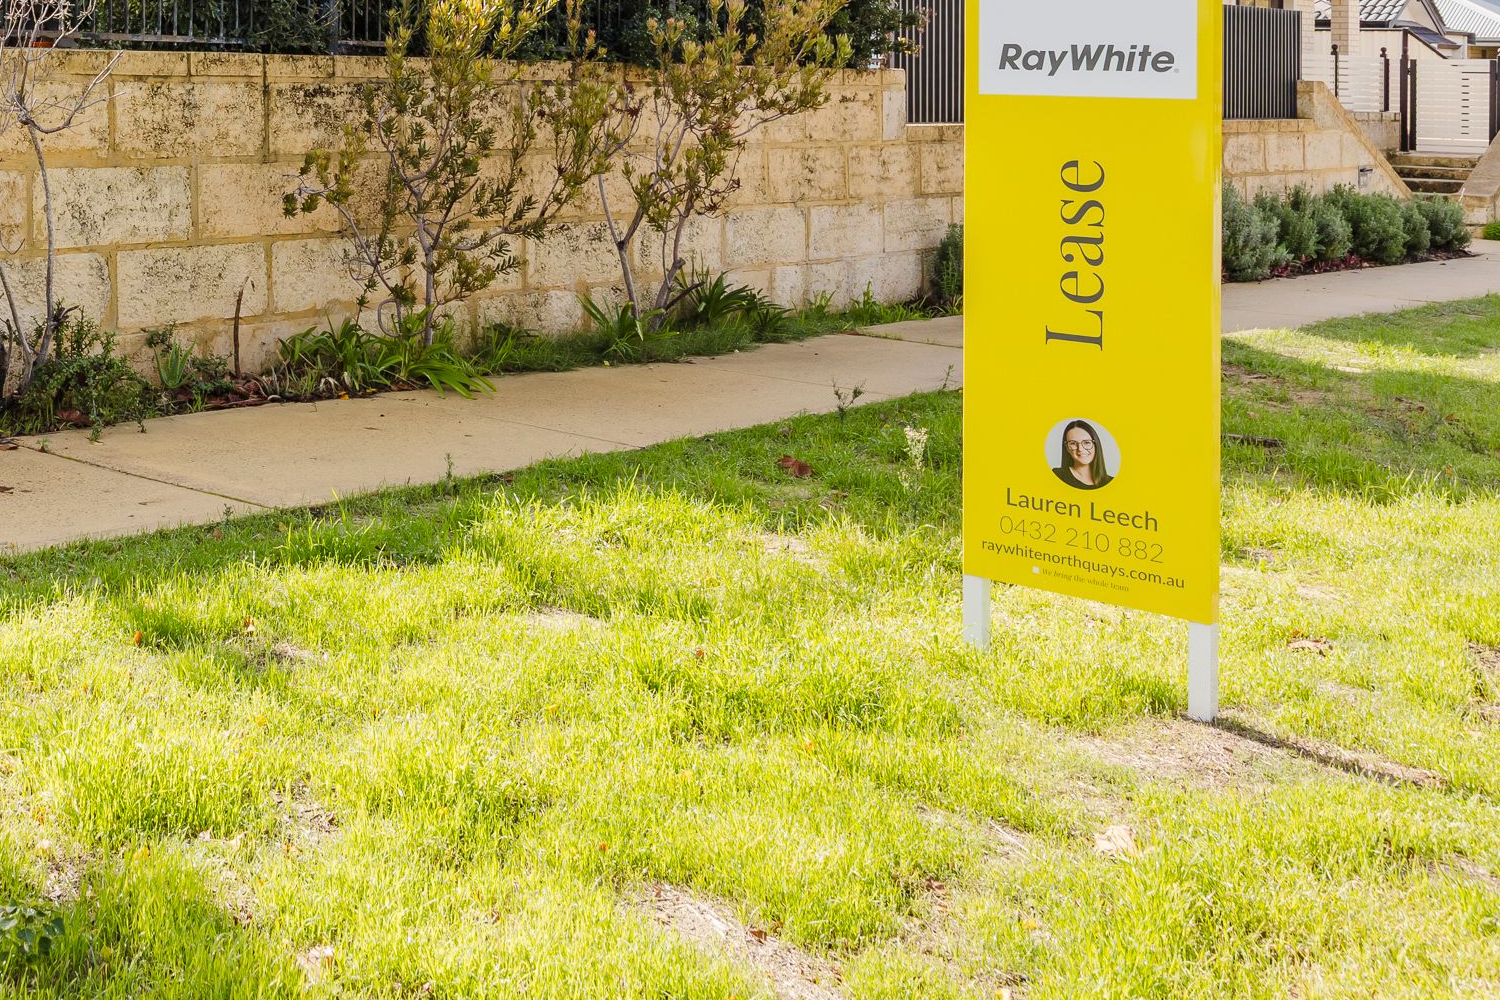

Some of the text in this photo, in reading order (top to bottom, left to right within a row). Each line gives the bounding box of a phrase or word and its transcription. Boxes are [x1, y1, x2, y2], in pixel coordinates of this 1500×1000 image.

[1045, 159, 1105, 352] Lease
[1006, 487, 1158, 532] Lauren Leech
[981, 539, 1185, 589] raywhitenorthquays.com.au
[999, 515, 1164, 564] 0432 210 882
[1053, 570, 1073, 582] bring
[1073, 575, 1086, 584] the
[1087, 578, 1109, 588] whole
[1110, 582, 1130, 592] team
